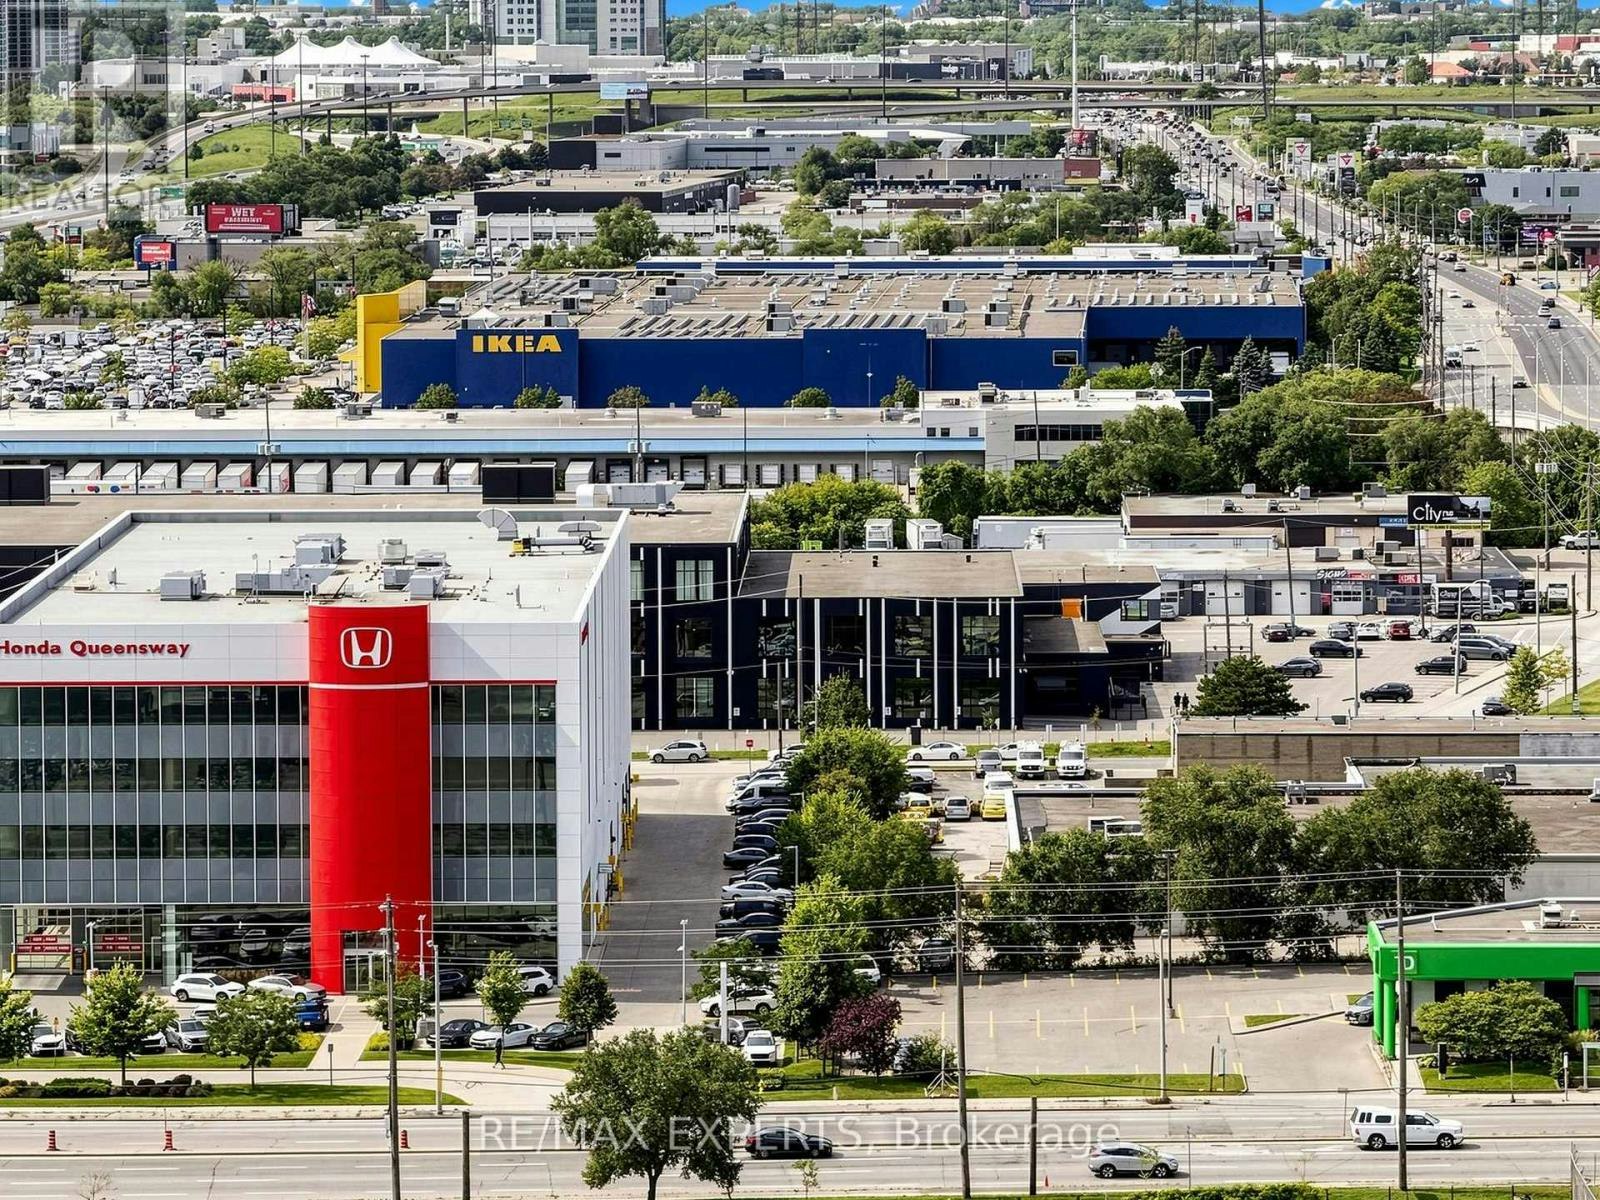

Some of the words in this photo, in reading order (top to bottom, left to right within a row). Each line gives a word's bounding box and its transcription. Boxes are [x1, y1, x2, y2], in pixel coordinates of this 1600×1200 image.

[472, 335, 562, 353] IKEA
[0, 640, 61, 655] Honda
[70, 640, 190, 658] Queensway
